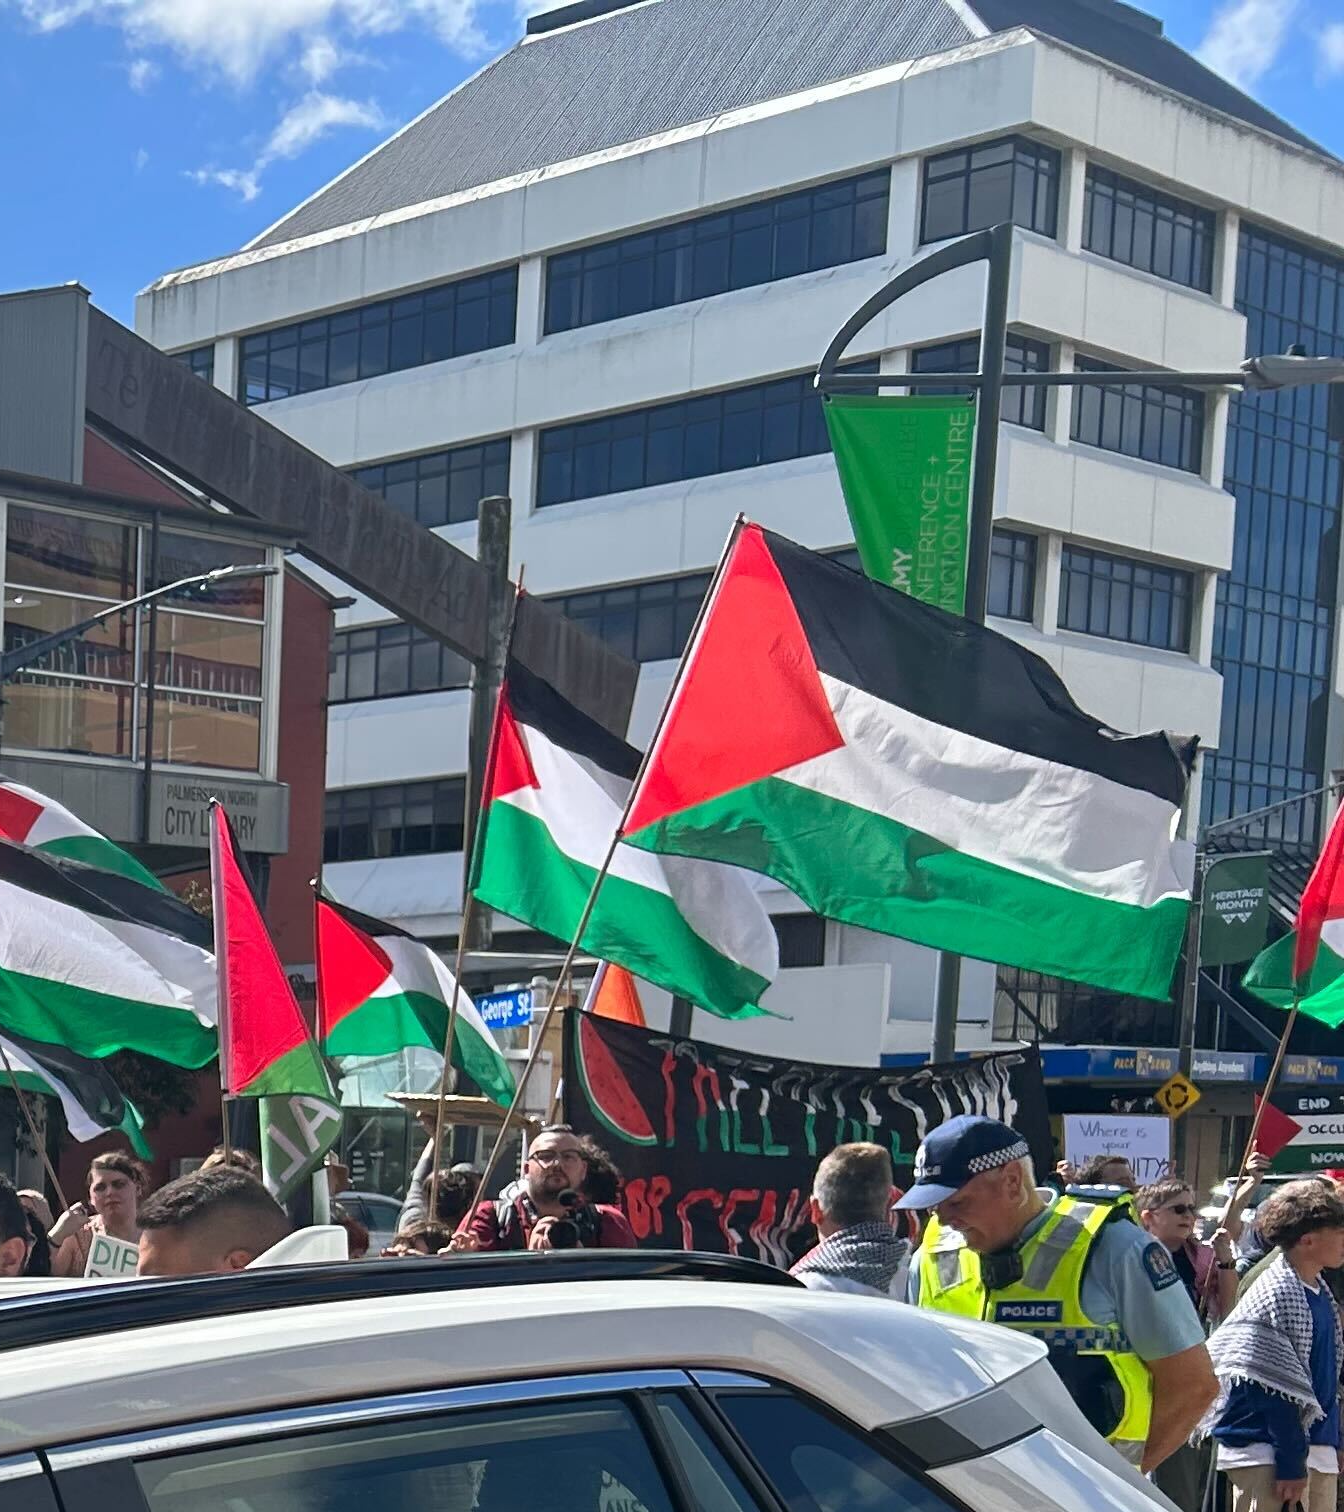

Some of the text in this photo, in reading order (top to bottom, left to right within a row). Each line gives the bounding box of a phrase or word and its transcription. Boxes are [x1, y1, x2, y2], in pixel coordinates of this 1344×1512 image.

[943, 411, 970, 508] CENTRE
[917, 472, 941, 600] NFERENCE
[892, 548, 912, 595] MY
[164, 806, 257, 840] CITY LARY
[1211, 888, 1264, 901] HERITAGE
[1216, 899, 1259, 910] MONTH
[481, 993, 530, 1024] George St
[1298, 1098, 1330, 1110] END
[1079, 1120, 1148, 1139] Where is
[1102, 1141, 1131, 1155] your
[1001, 1305, 1057, 1318] POLICE
